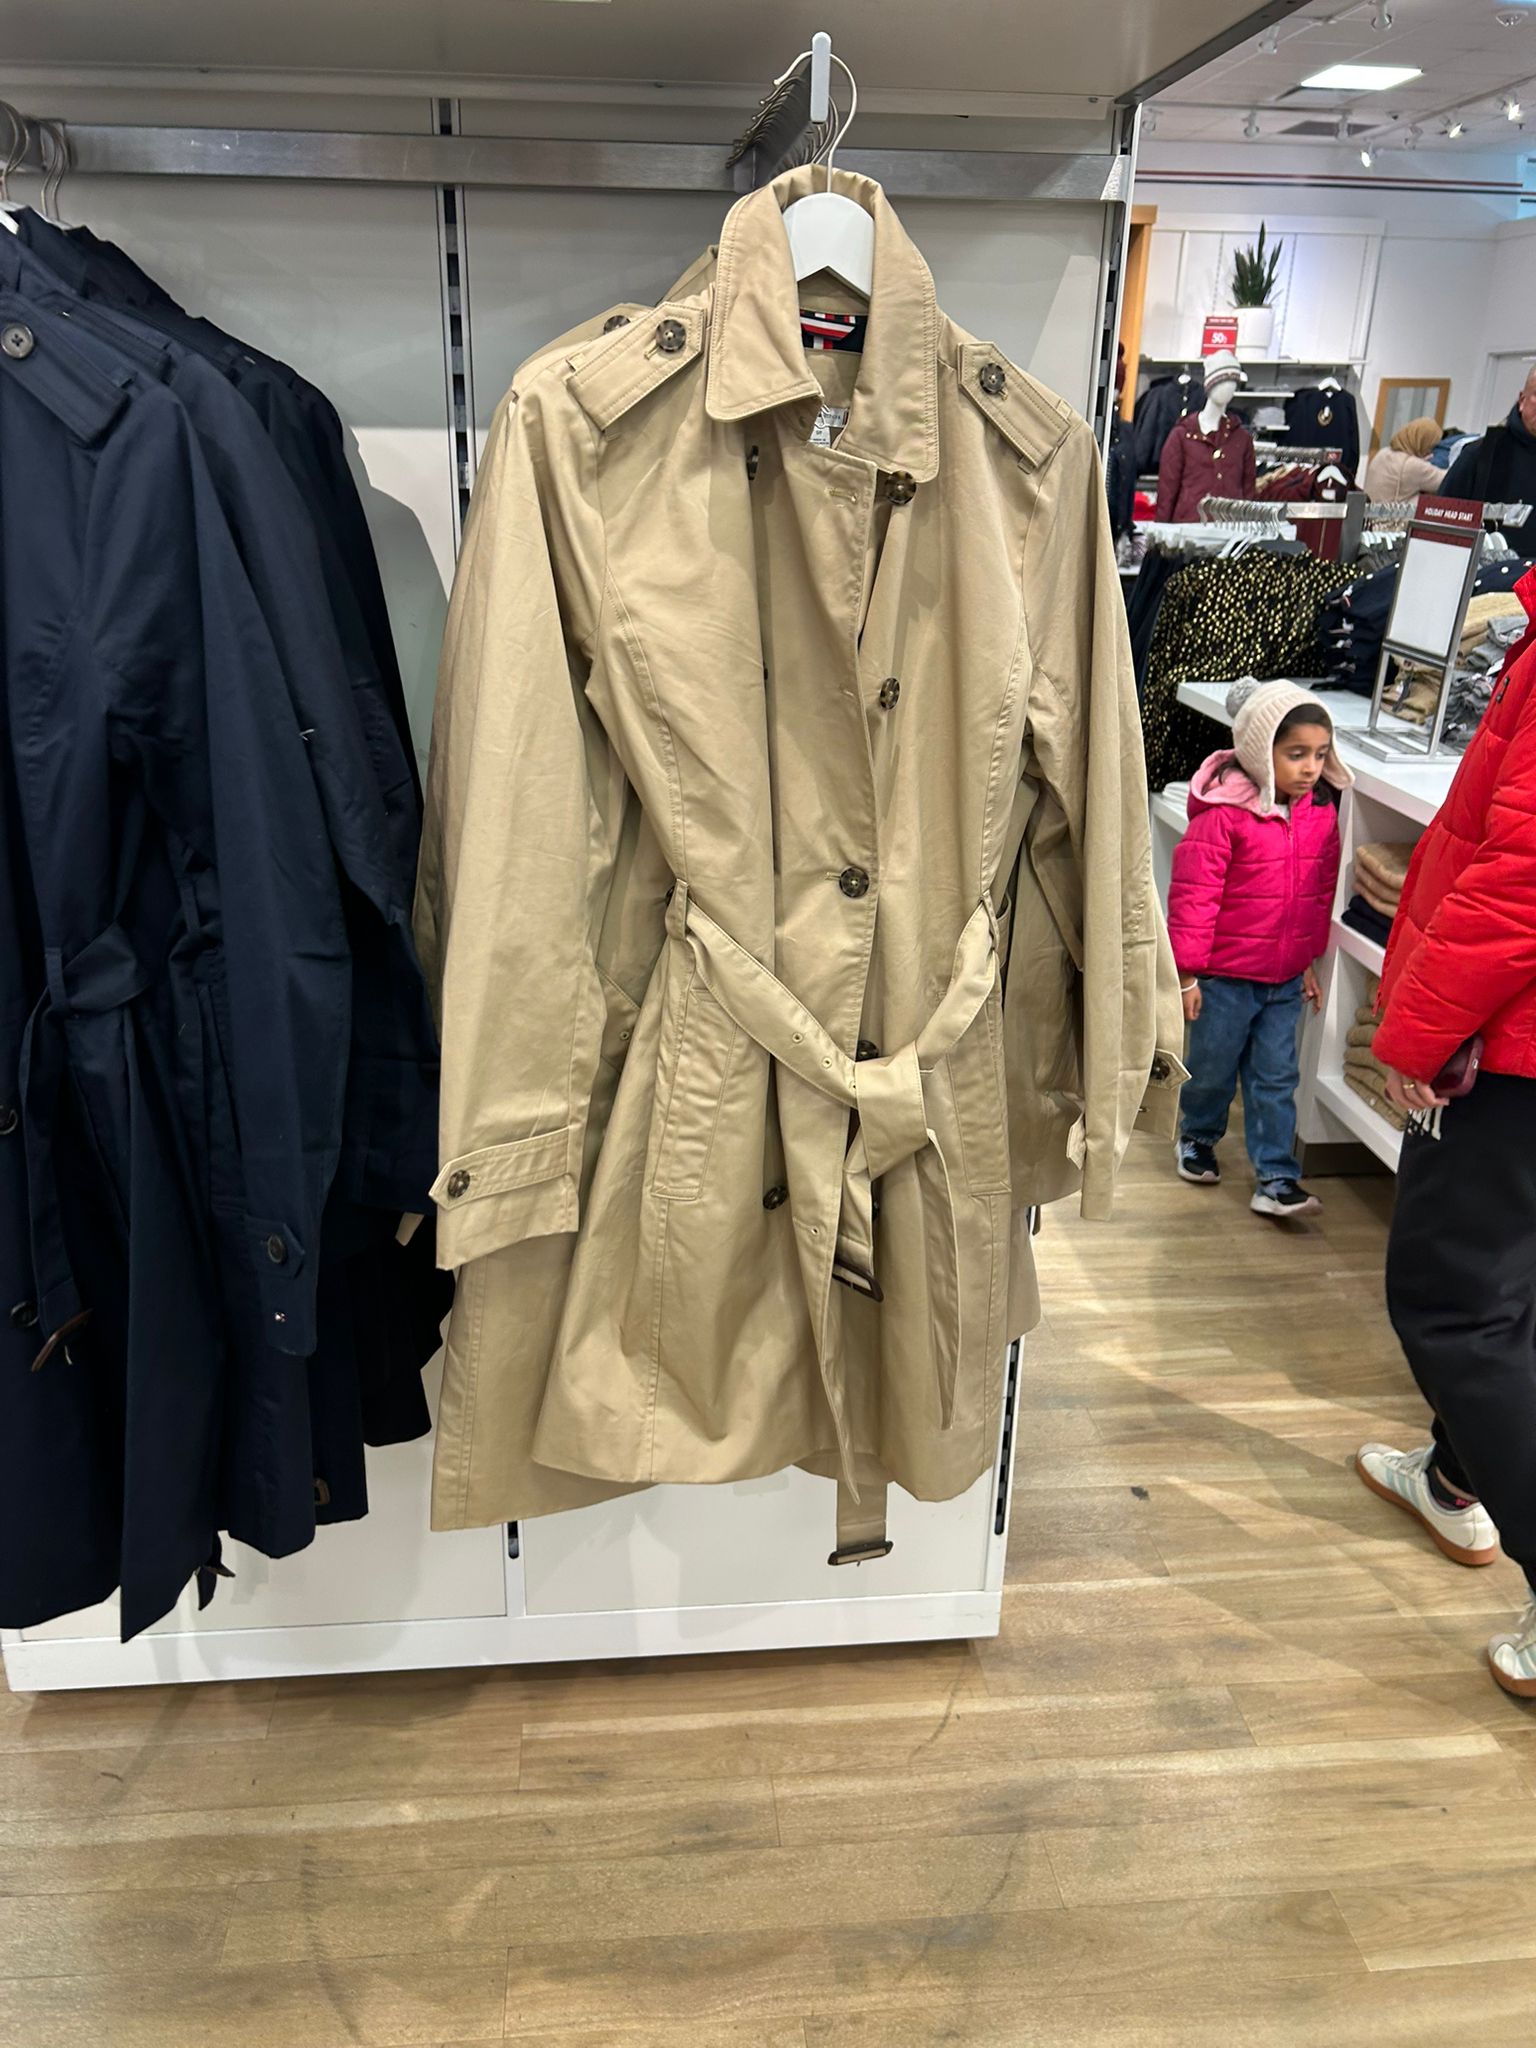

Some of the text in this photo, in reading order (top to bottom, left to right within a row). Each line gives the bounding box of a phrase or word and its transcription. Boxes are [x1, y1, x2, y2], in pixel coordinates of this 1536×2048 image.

[1424, 507, 1474, 522] HOLIDAY HEAD START
